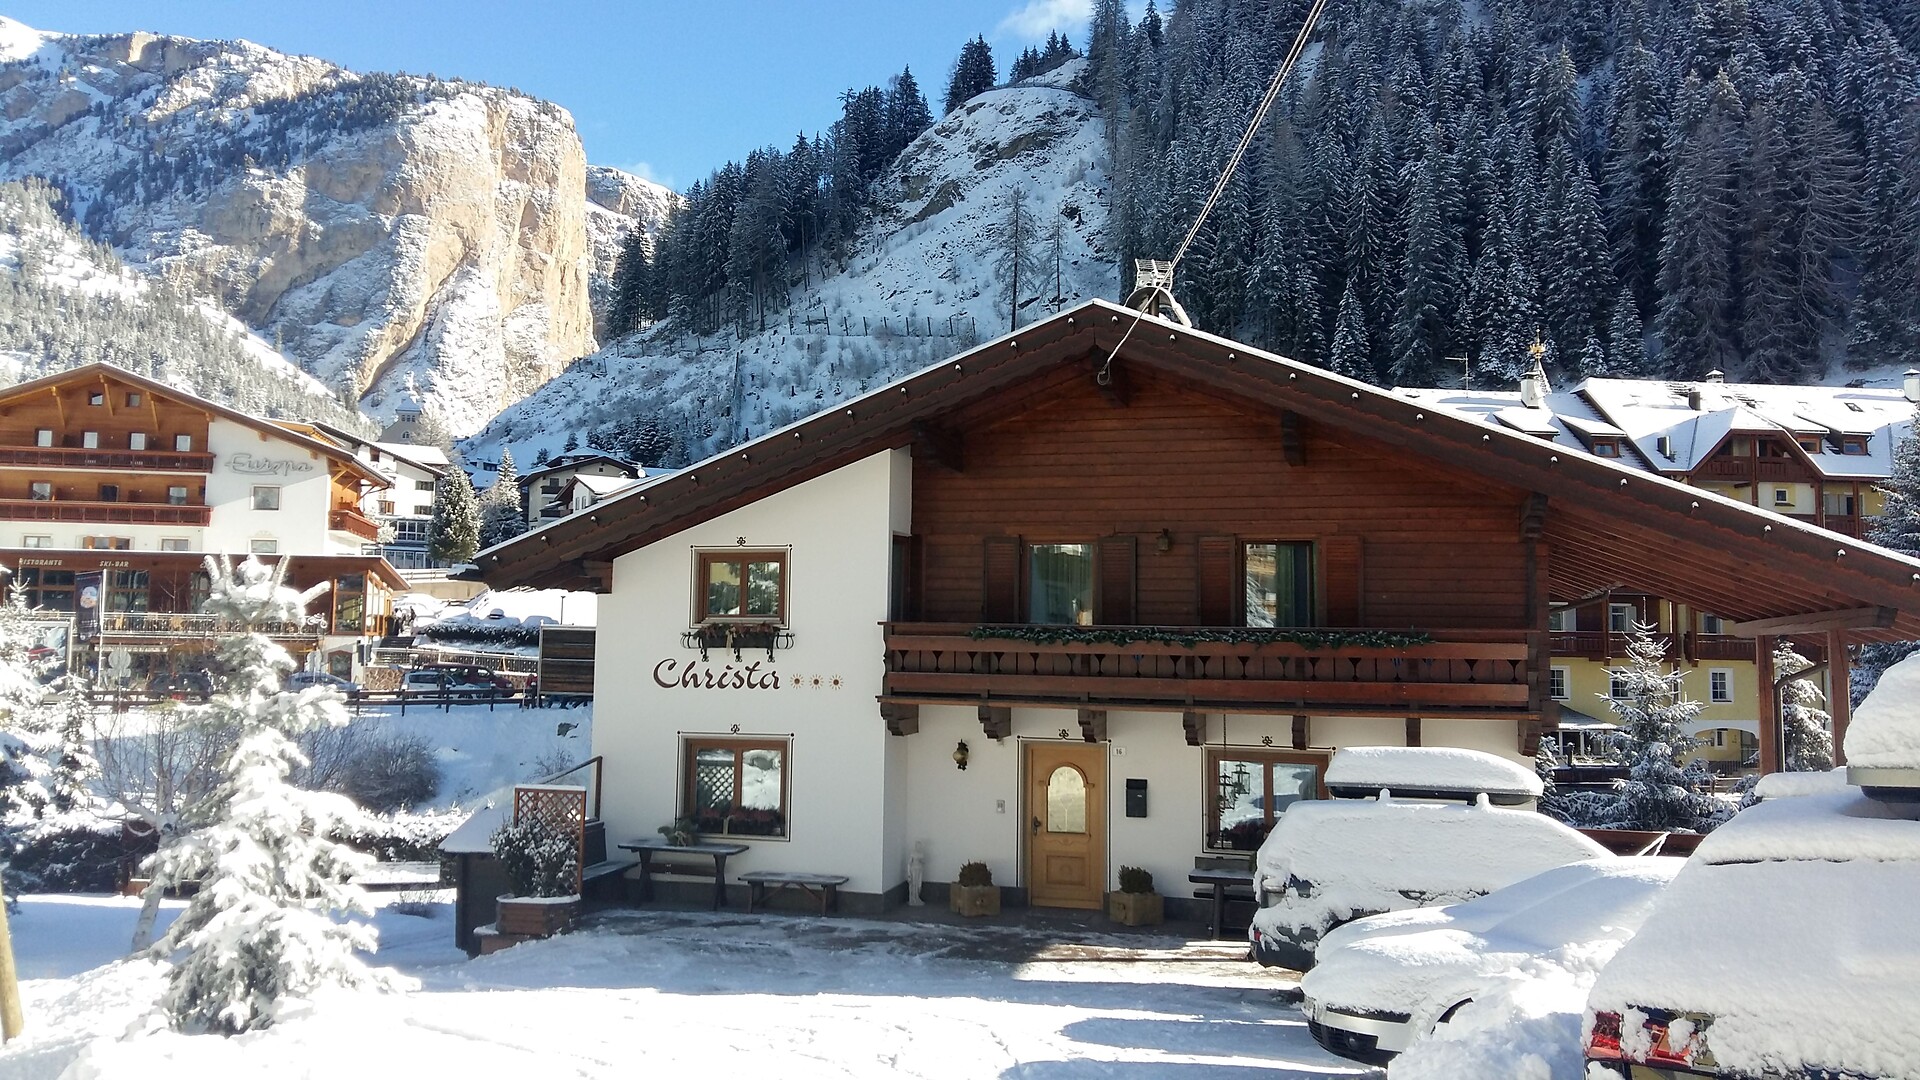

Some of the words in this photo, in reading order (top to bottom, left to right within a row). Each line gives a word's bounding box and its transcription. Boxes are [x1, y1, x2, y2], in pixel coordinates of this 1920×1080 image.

[224, 453, 314, 476] Europa
[99, 560, 129, 568] SKI-BAR
[653, 658, 781, 690] Christa
